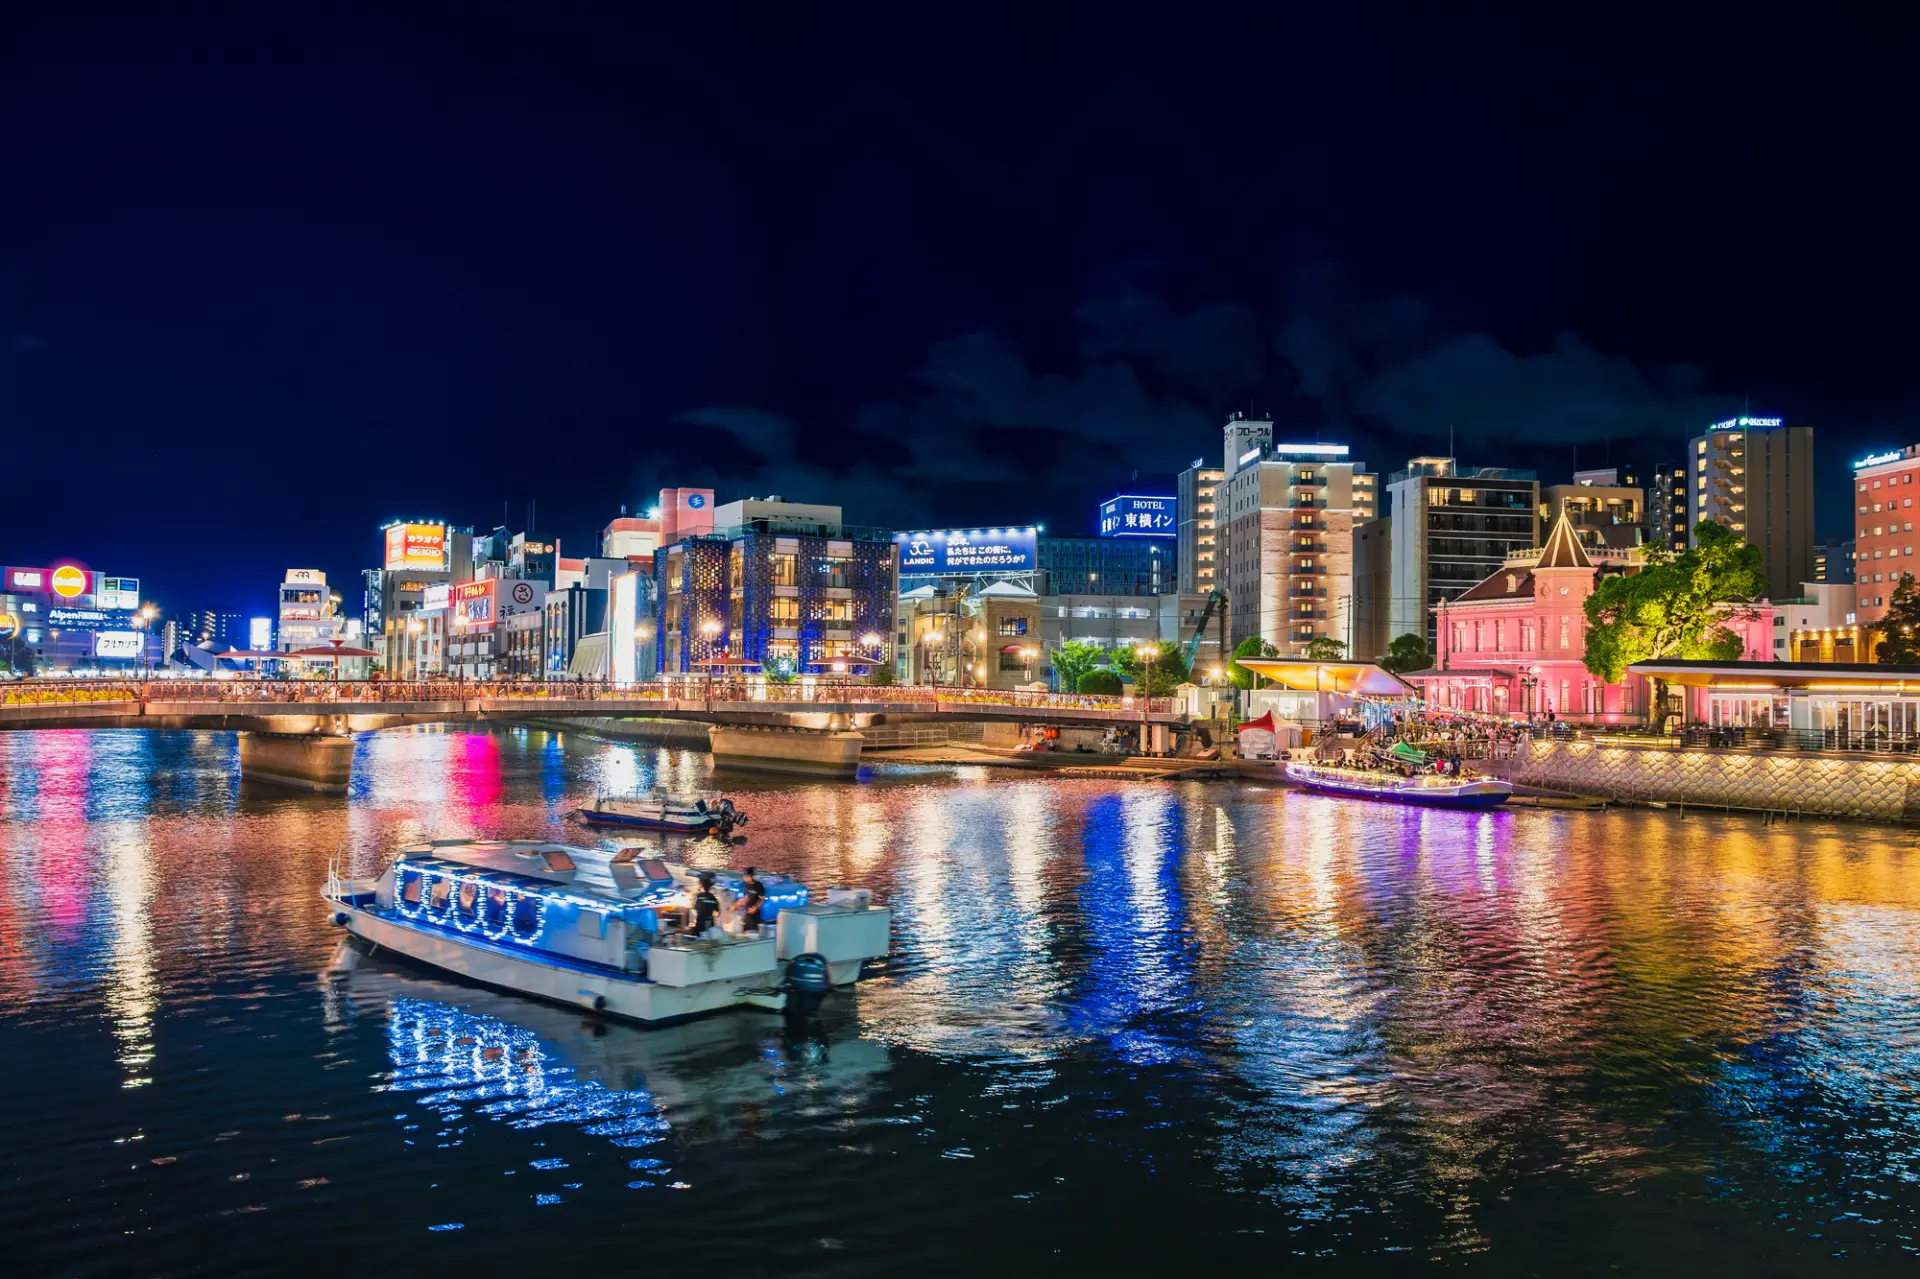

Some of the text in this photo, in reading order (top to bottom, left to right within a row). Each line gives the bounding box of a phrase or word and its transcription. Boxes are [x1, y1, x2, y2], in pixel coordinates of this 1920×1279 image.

[1236, 427, 1271, 437] フローラル
[1133, 500, 1165, 510] HOTEL
[1124, 512, 1173, 528] 東横イン
[407, 535, 441, 544] カラオケ
[903, 557, 935, 566] LANDIC
[49, 610, 79, 621] Alpen
